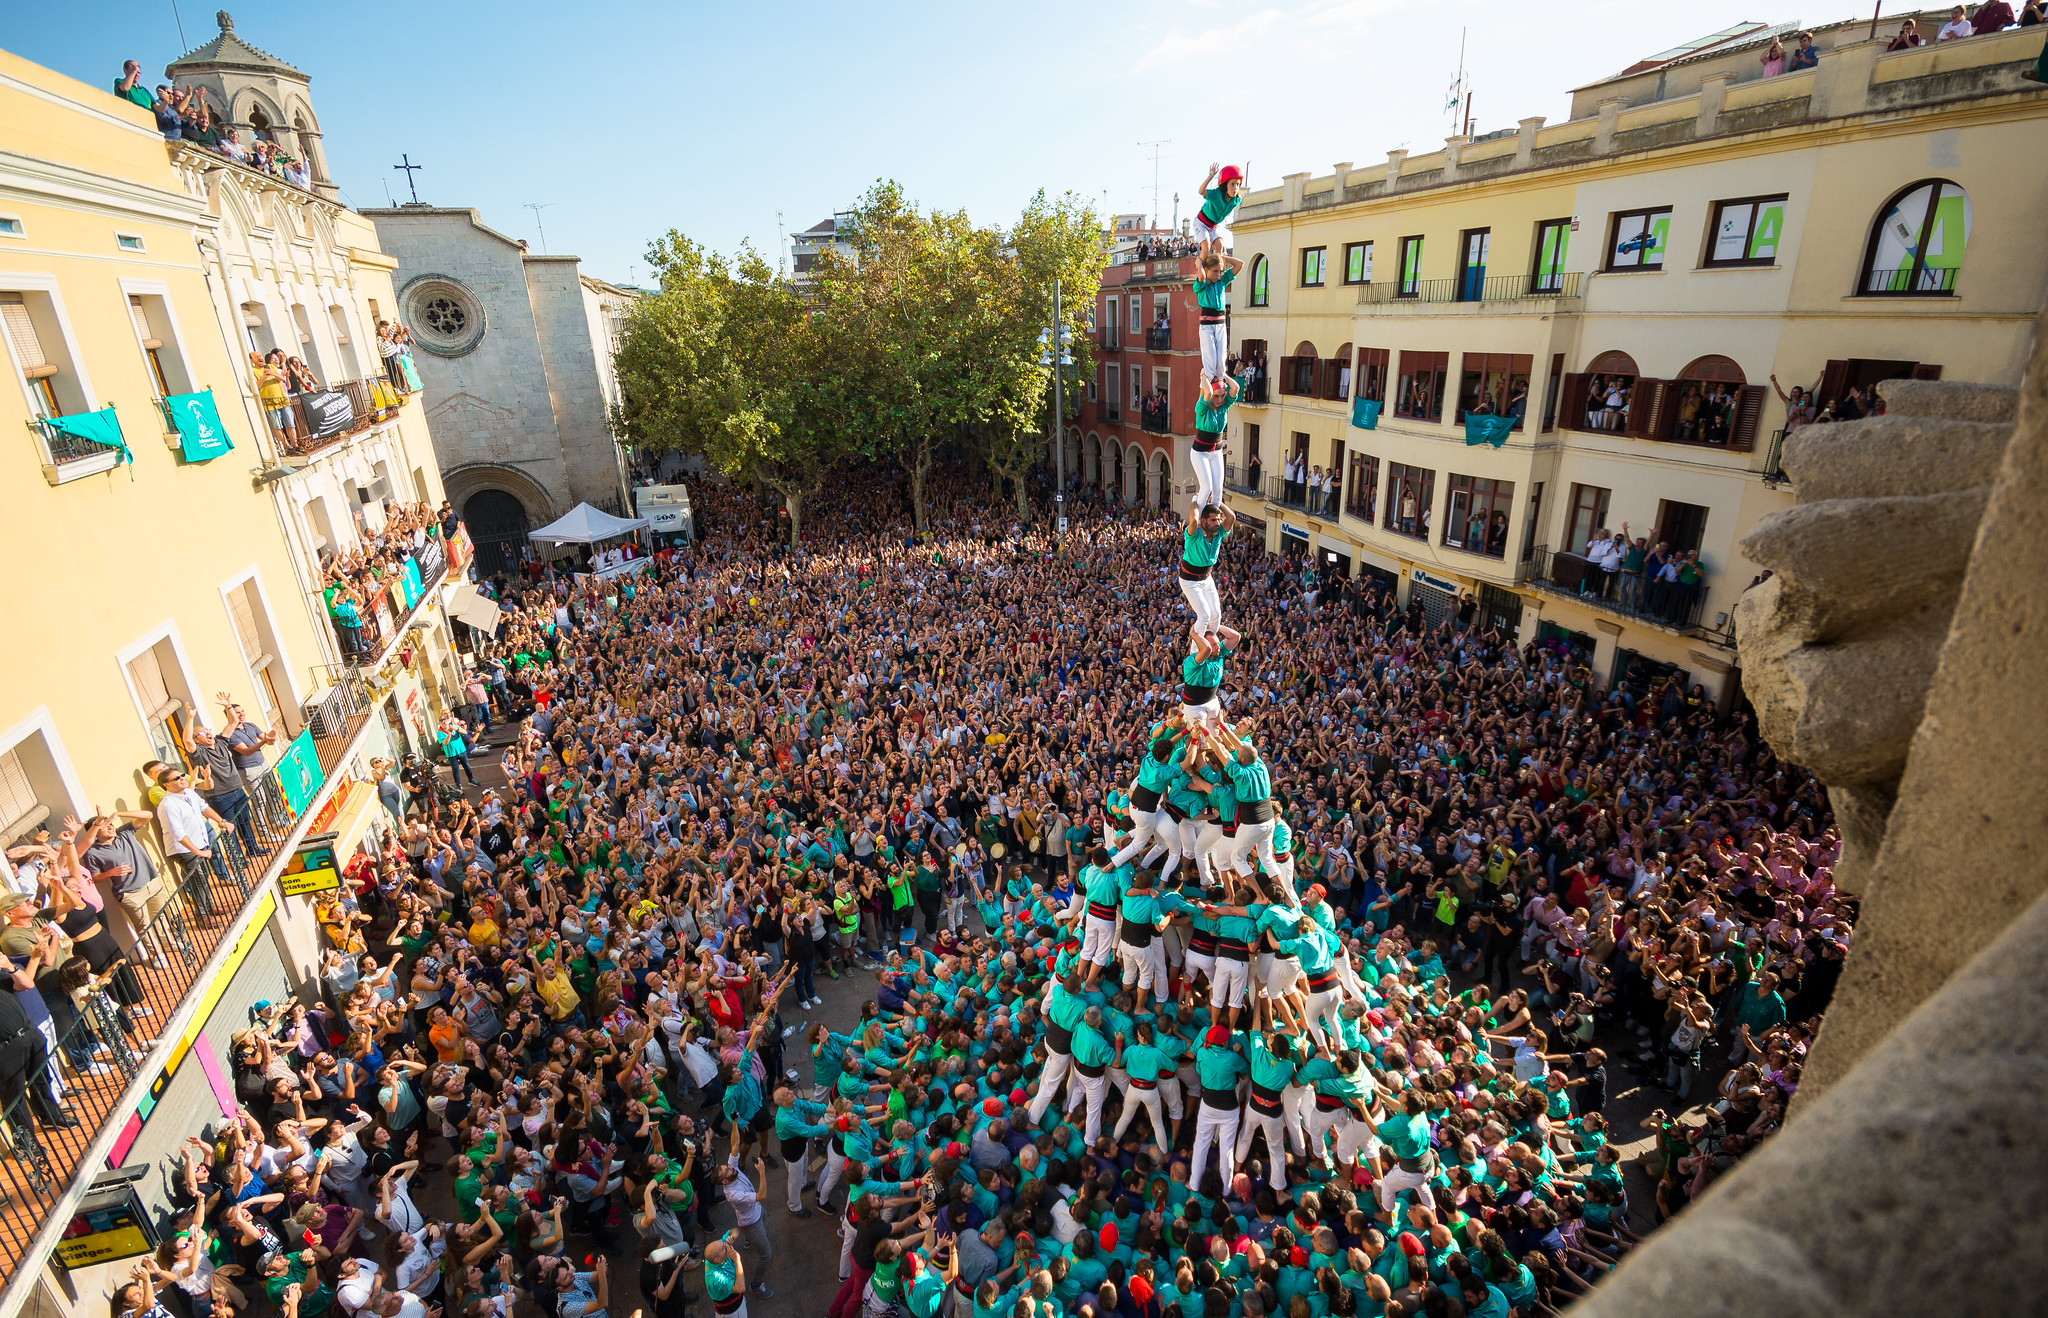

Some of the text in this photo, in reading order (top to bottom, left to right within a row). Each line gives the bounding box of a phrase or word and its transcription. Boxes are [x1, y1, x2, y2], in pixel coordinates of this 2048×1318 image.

[1642, 218, 1670, 264] A
[1749, 206, 1783, 258] A
[1306, 254, 1318, 283] A
[1349, 249, 1361, 281] A
[284, 882, 317, 890] viatges
[58, 1243, 87, 1254] som
[61, 1246, 113, 1261] viatges
